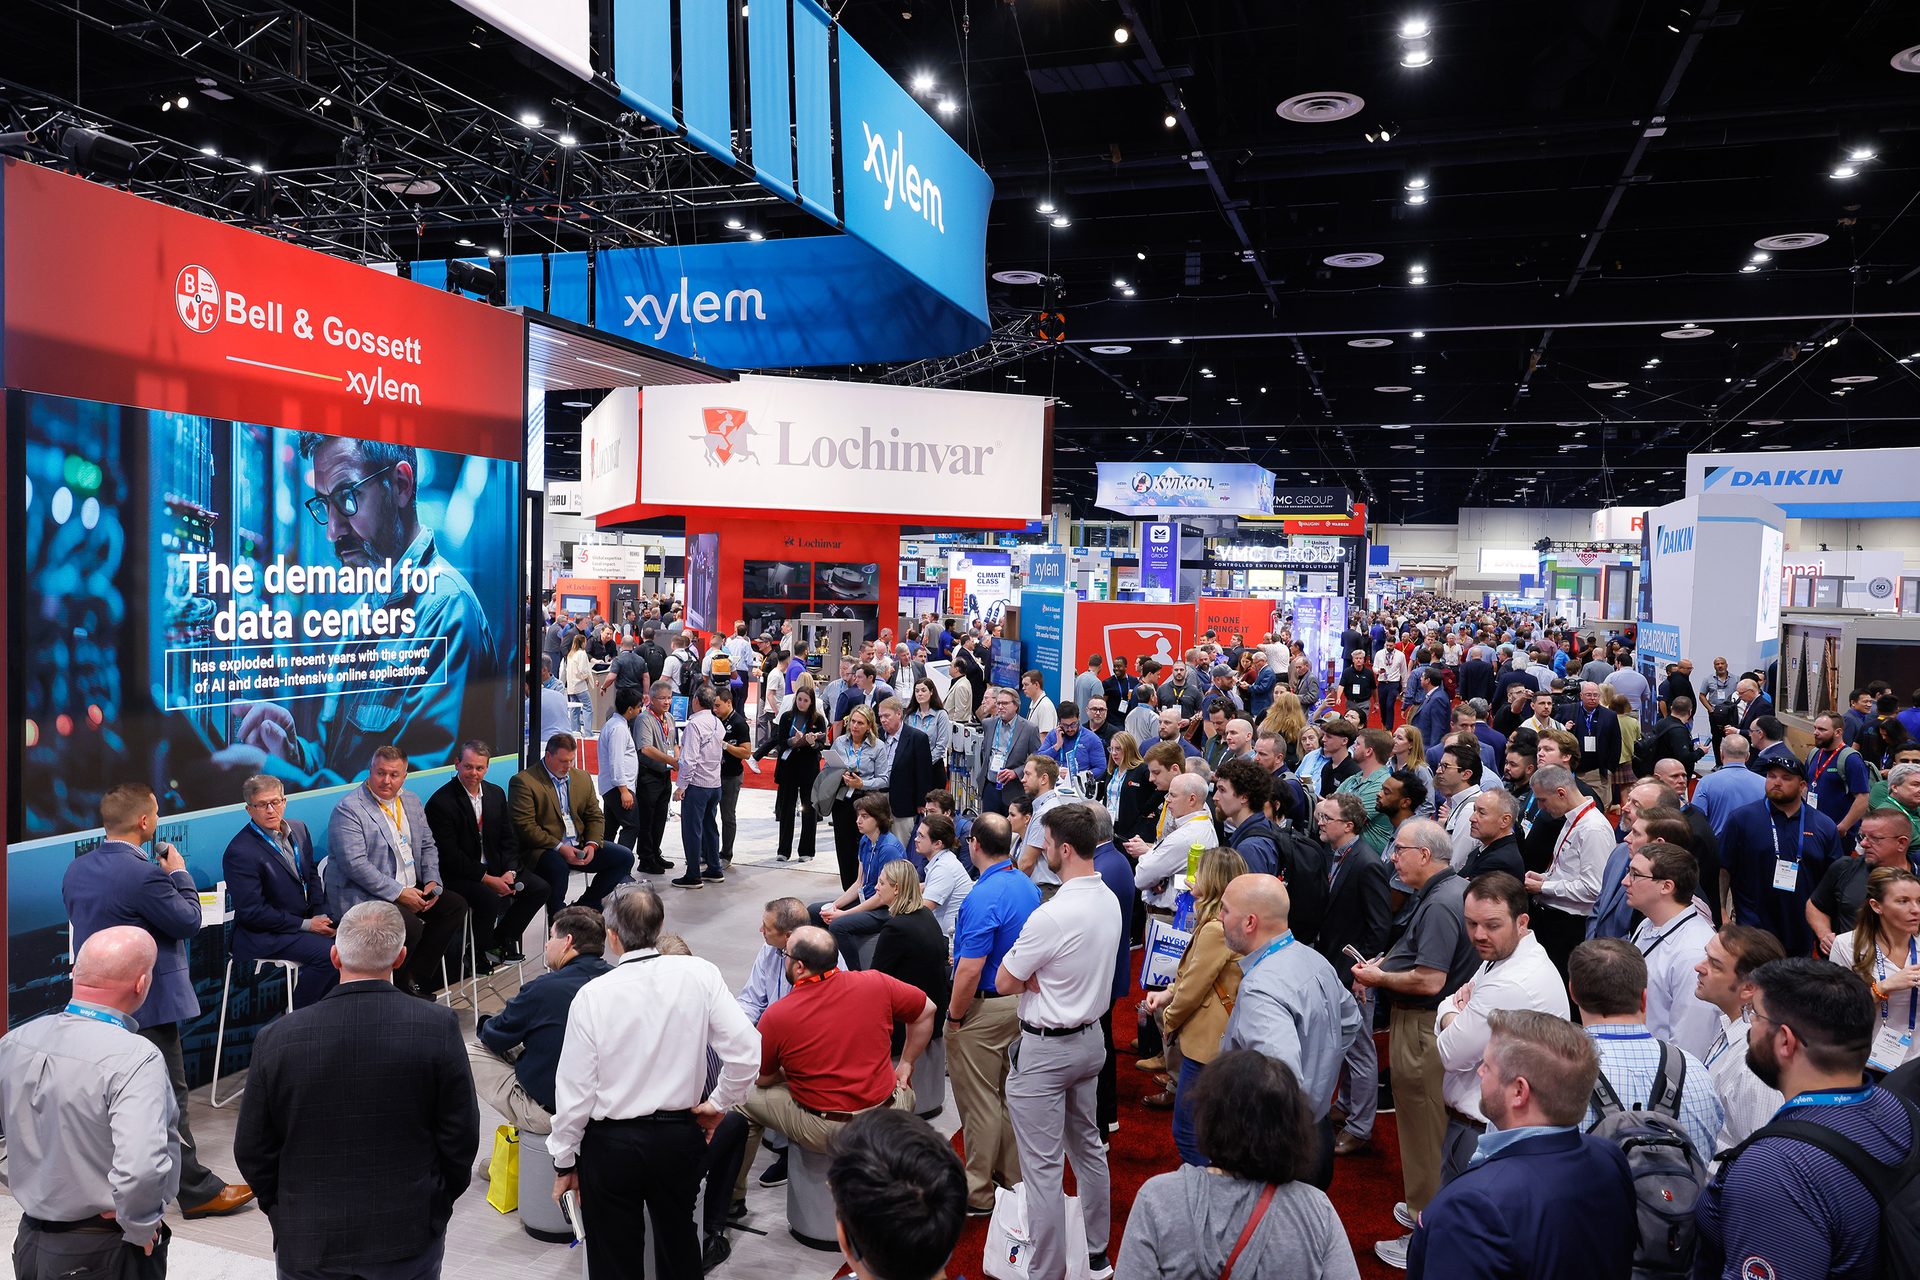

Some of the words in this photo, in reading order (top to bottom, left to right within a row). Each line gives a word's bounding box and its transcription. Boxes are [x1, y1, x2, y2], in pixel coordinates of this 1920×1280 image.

[862, 120, 945, 234] xylem
[185, 273, 195, 293] B
[623, 276, 767, 340] xylem
[225, 291, 283, 334] Bell
[293, 308, 314, 341] &
[323, 316, 422, 365] Gossett
[346, 366, 422, 406] xylem
[1730, 469, 1844, 486] DAIKIN
[1295, 495, 1334, 505] GROUP
[798, 538, 843, 549] Lochinvar
[1663, 526, 1695, 555] DAIKIN
[1271, 546, 1346, 563] GROUP
[180, 551, 254, 594] The
[264, 554, 393, 594] demand
[400, 558, 440, 594] for
[1034, 557, 1060, 582] xylem
[214, 600, 293, 641] data
[303, 602, 416, 637] centers
[1208, 625, 1239, 633] BRINGS
[1222, 616, 1240, 624] ONE
[1640, 628, 1679, 657] DECARBONIZE
[192, 658, 216, 674] has
[219, 653, 275, 676] exploded
[277, 654, 288, 669] in
[290, 653, 326, 668] recent
[328, 653, 356, 671] years
[358, 648, 379, 662] with
[381, 647, 397, 662] the
[398, 646, 430, 664] growth
[194, 678, 209, 694] of
[211, 677, 226, 693] AI
[228, 674, 251, 691] and
[253, 671, 334, 689] data-intensive
[336, 669, 368, 684] online
[369, 665, 429, 684] applications.
[1153, 973, 1176, 986] YA
[1792, 1096, 1814, 1104] xylem
